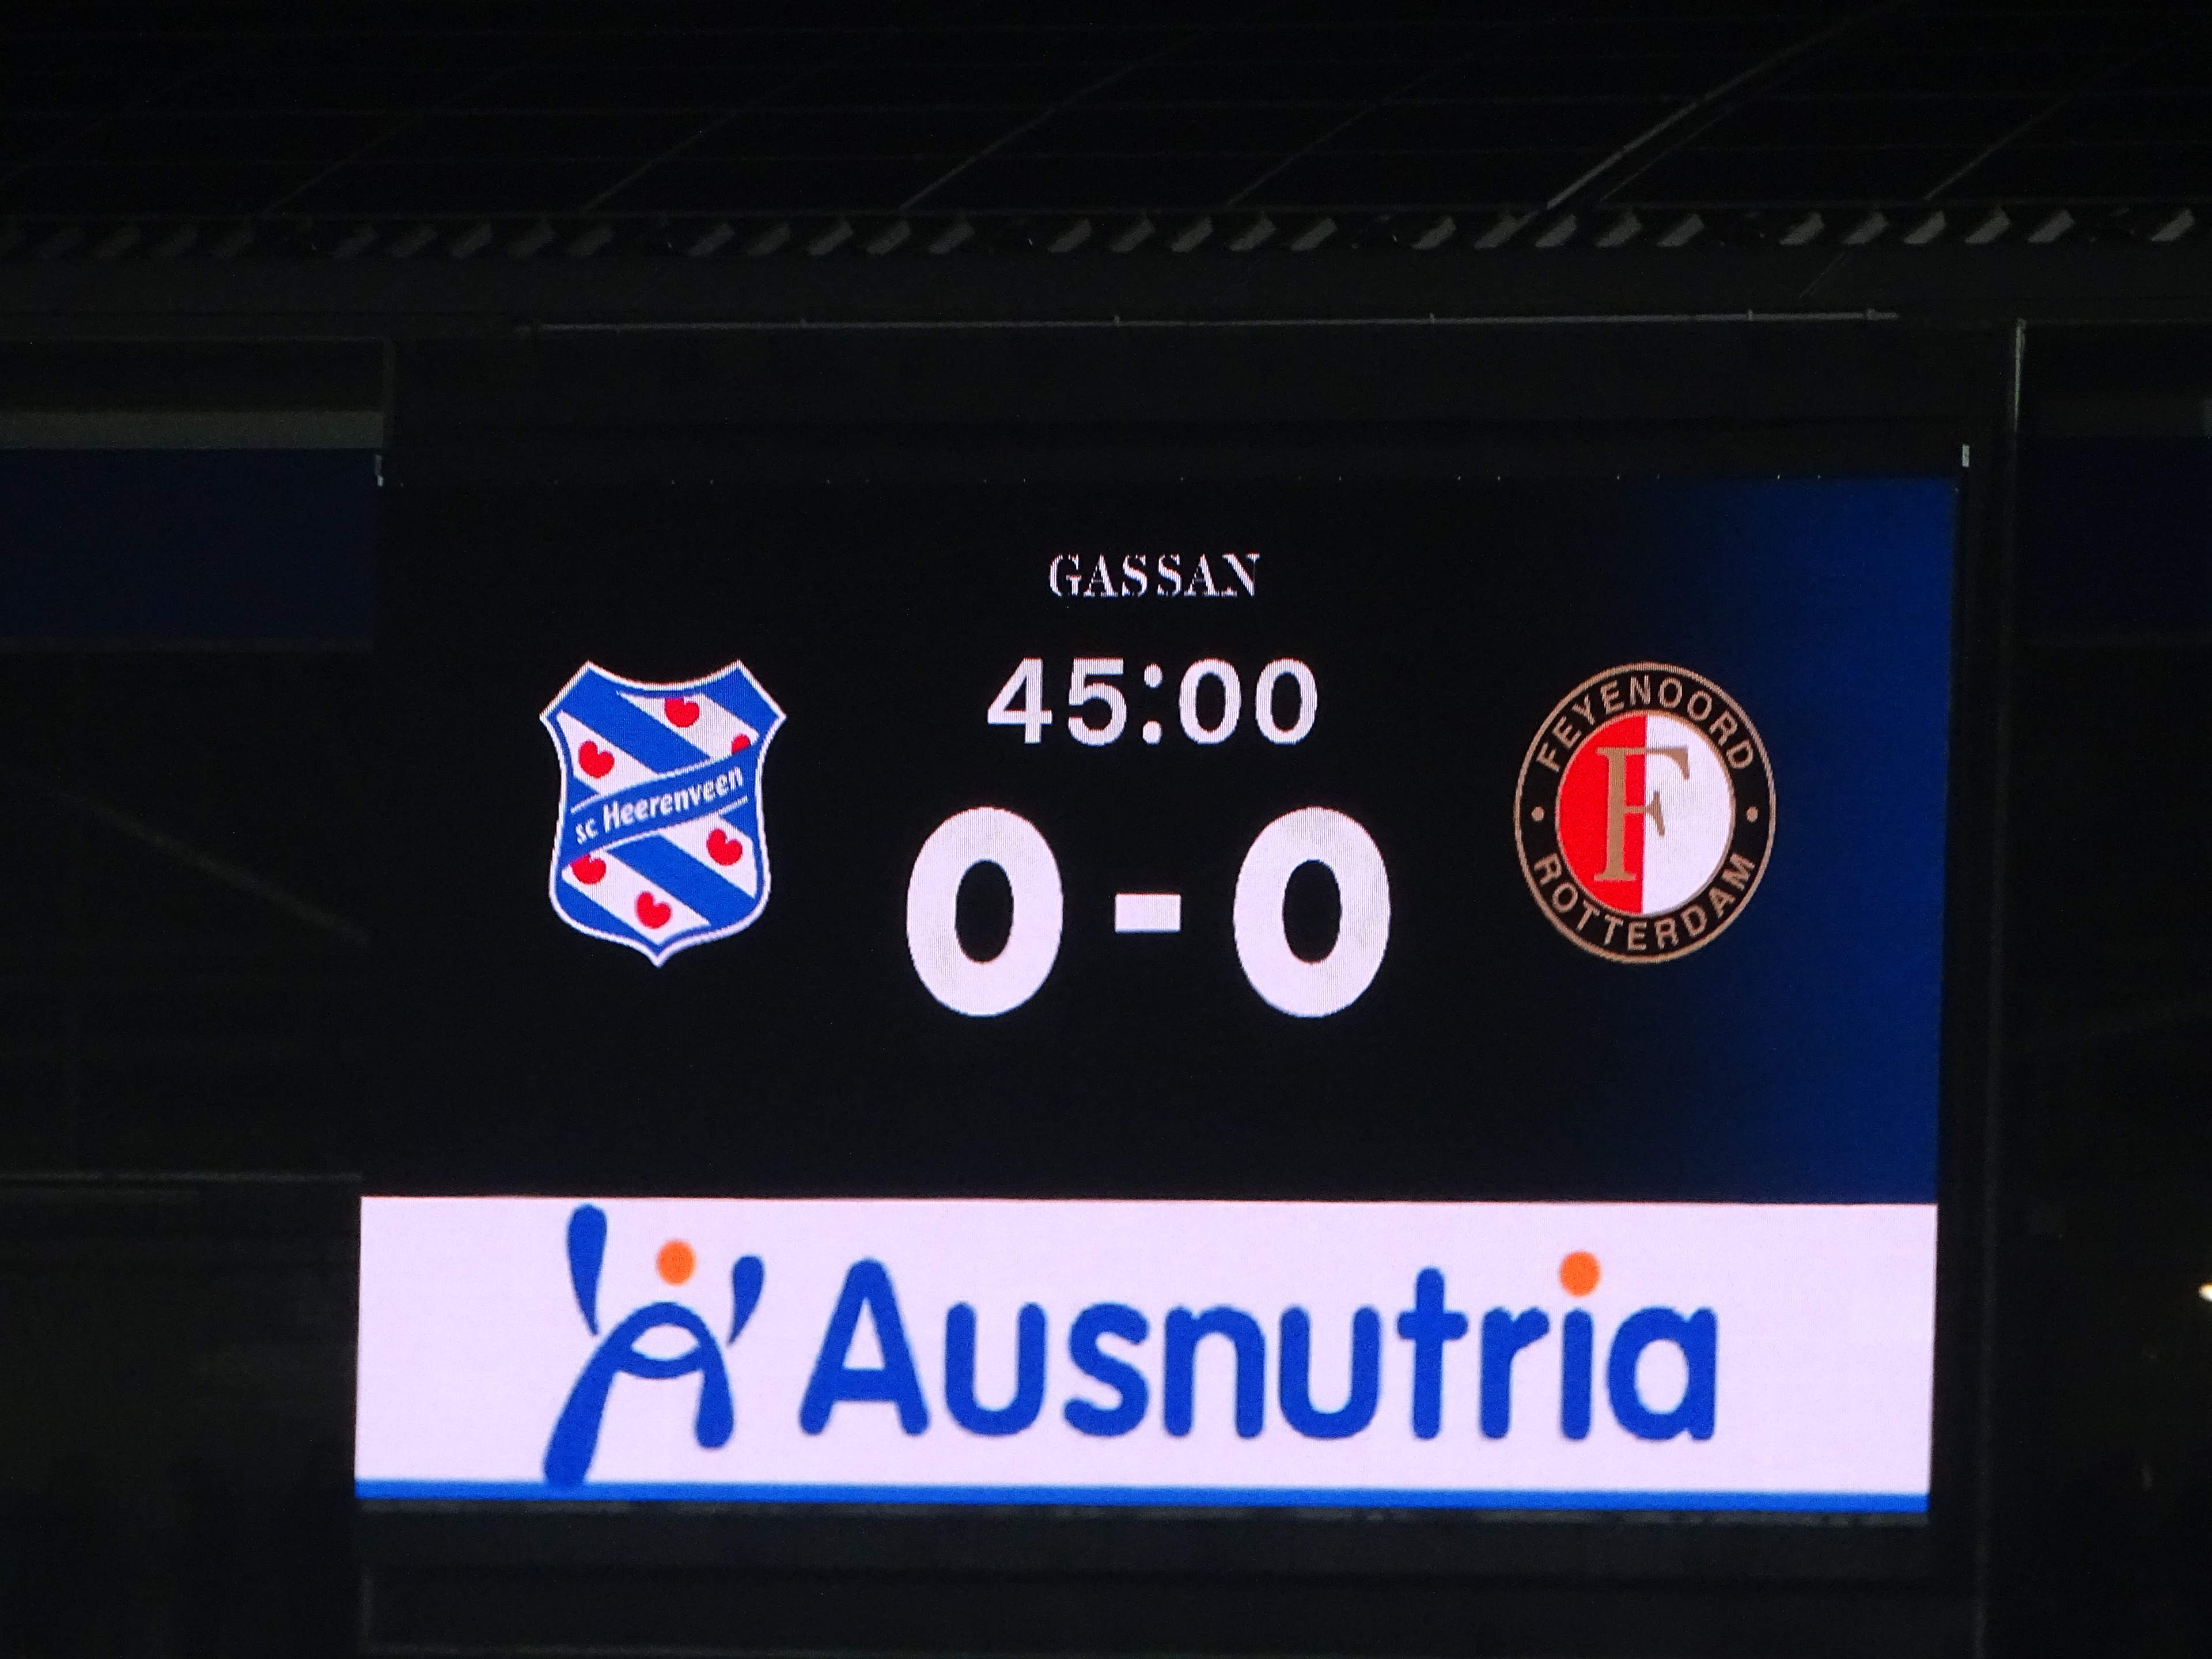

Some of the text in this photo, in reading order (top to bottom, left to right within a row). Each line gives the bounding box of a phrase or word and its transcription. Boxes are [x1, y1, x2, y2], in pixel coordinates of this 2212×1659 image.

[1049, 552, 1260, 598] GASSAN
[987, 657, 1319, 747] 45:00
[1535, 674, 1755, 774] FEYENOORD
[575, 766, 744, 844] sc Heerenveen
[1595, 746, 1691, 883] F
[1533, 853, 1756, 952] ROTTERDAM
[800, 1251, 1716, 1440] Ausnutria
